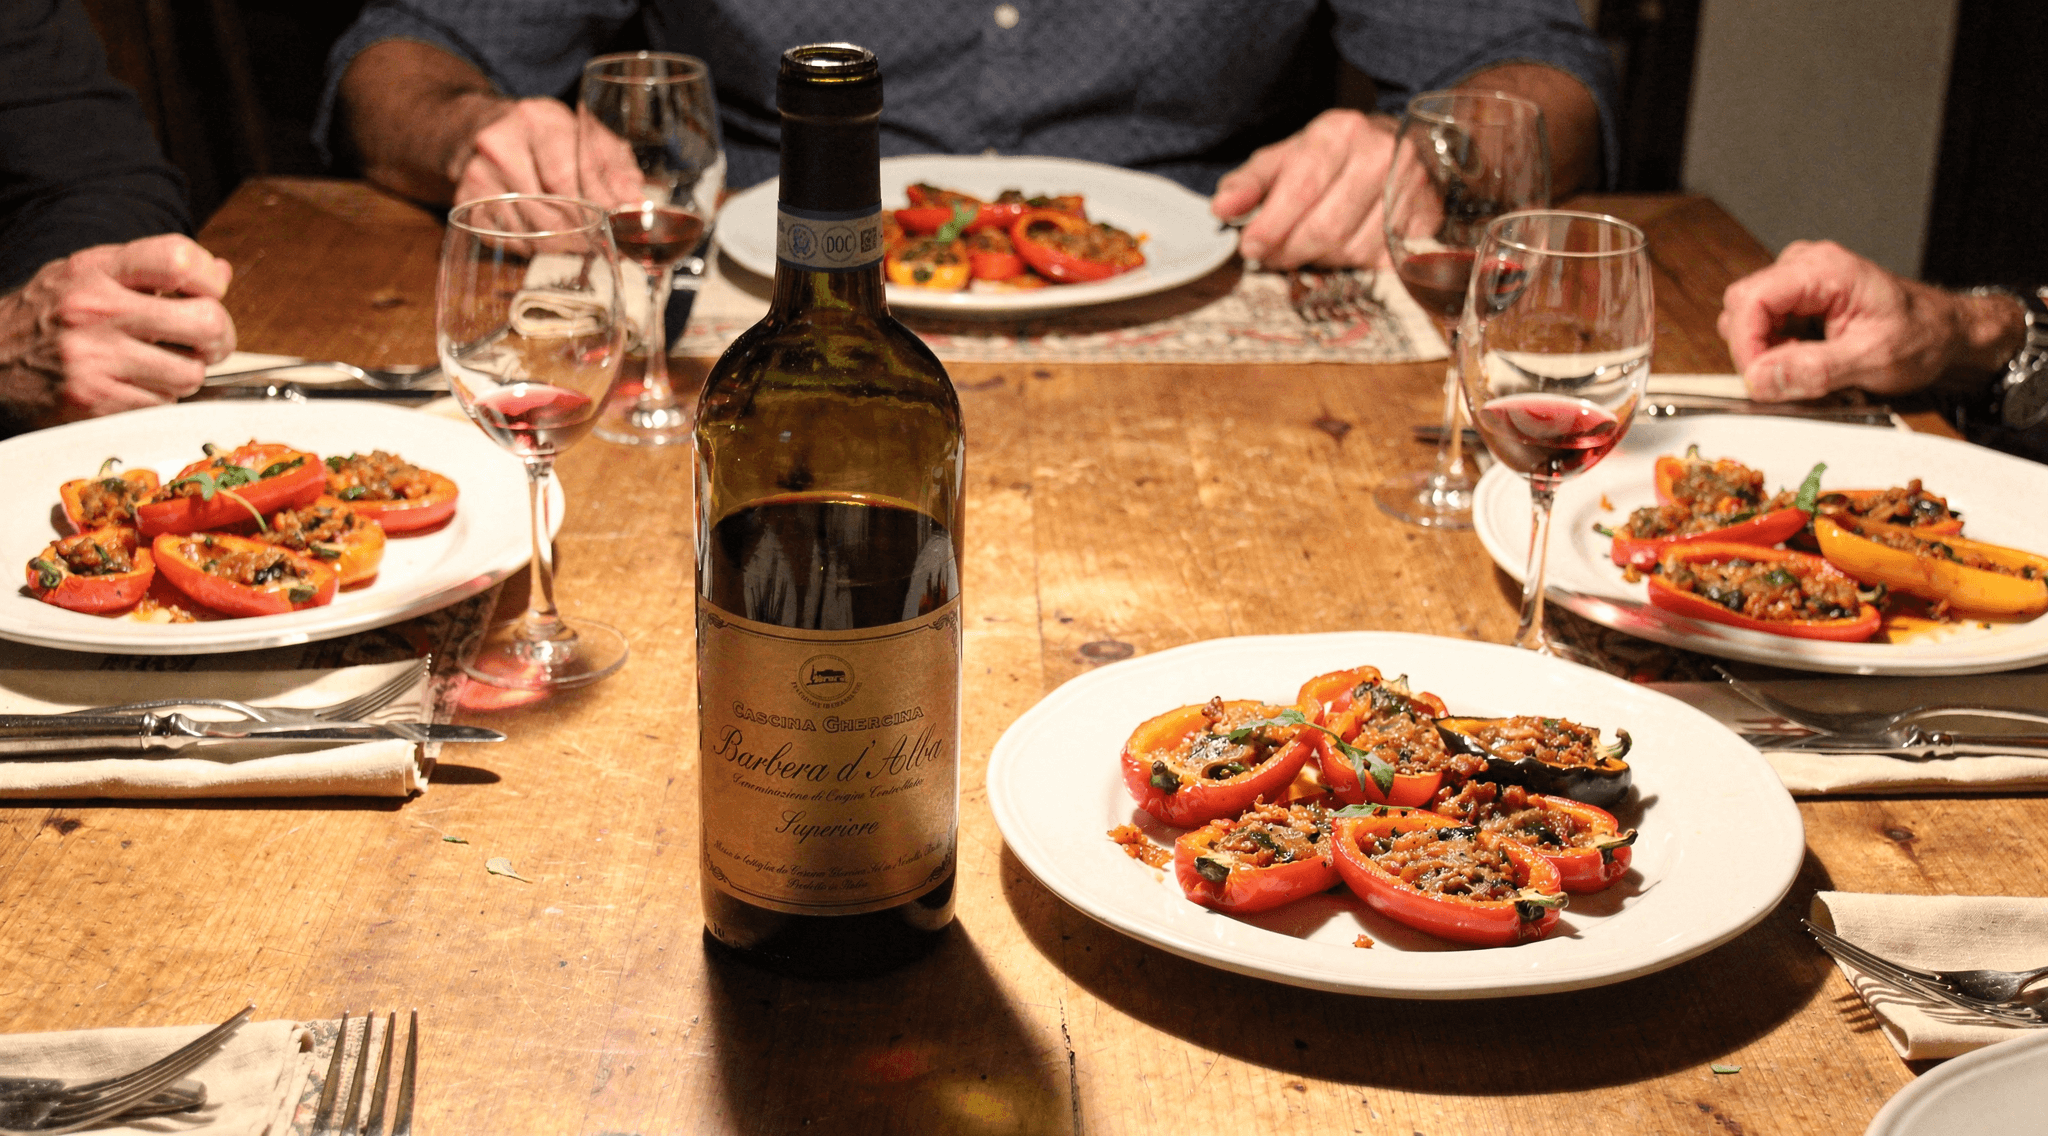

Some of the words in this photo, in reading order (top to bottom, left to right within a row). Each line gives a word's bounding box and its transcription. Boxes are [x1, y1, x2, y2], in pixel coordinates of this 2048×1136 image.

[826, 235, 854, 254] DOC
[732, 700, 817, 732] CASCINA
[823, 706, 924, 733] GHERCINA
[713, 724, 830, 782] Barbera
